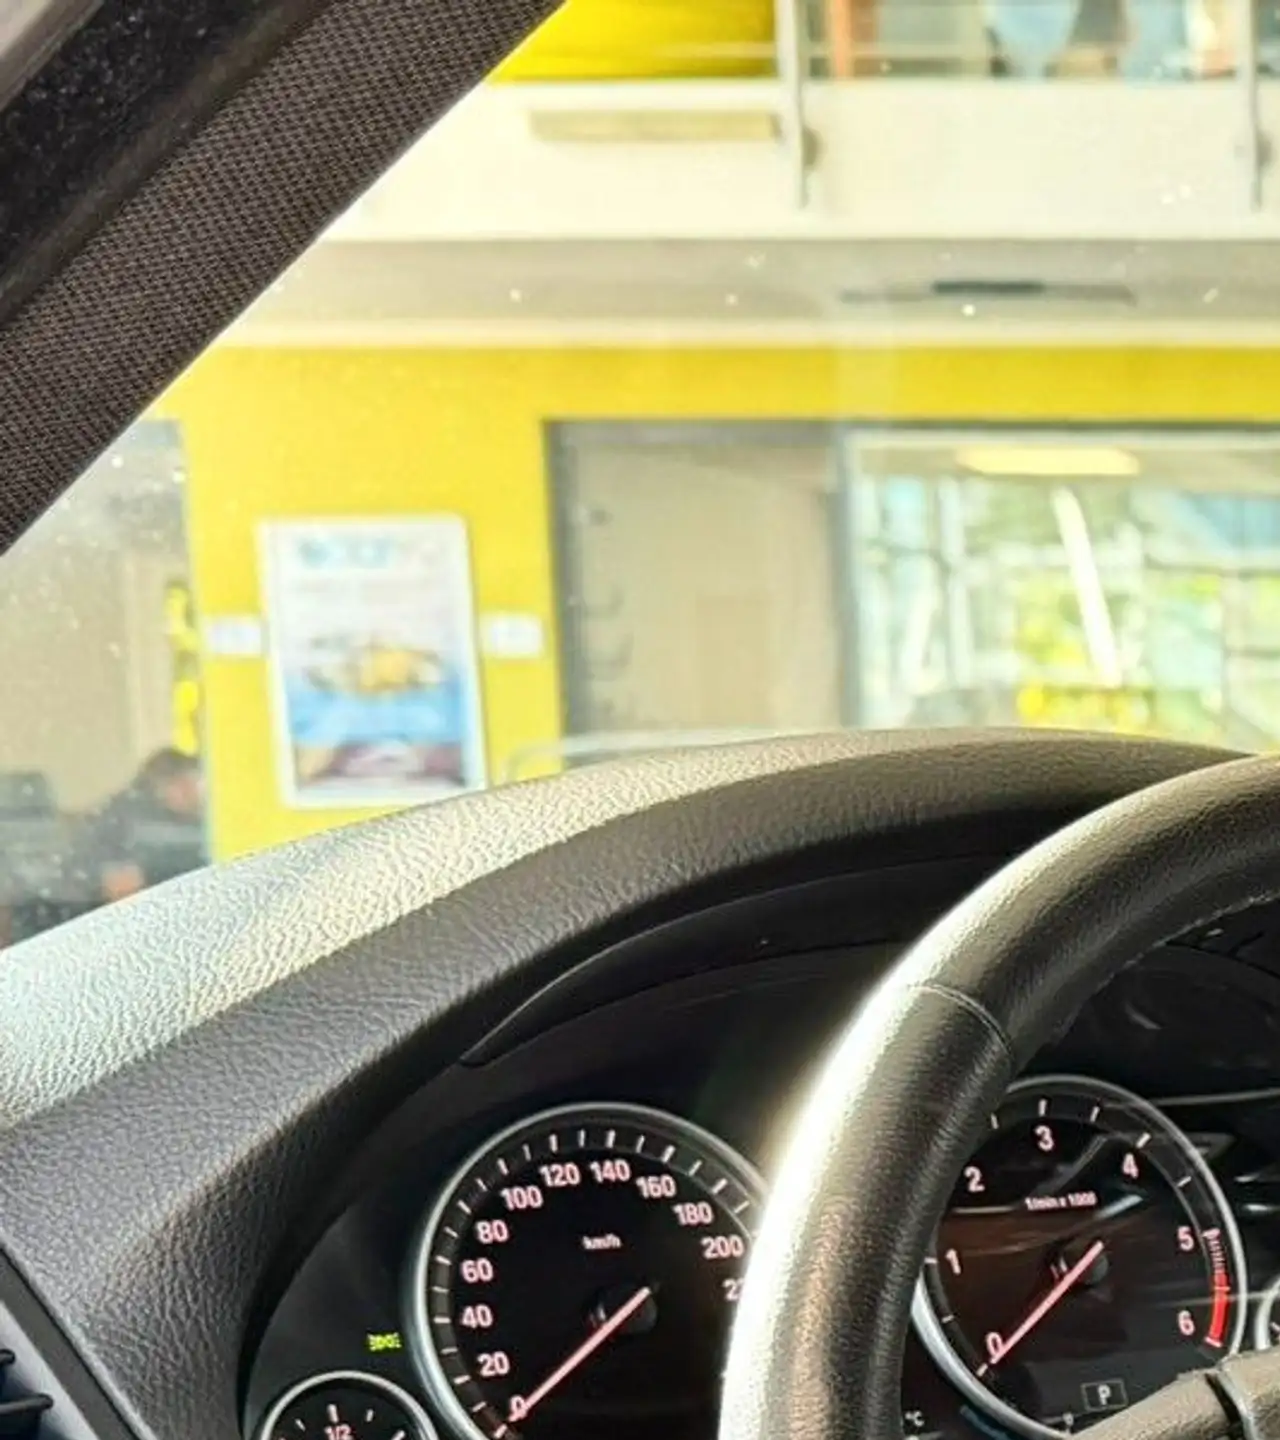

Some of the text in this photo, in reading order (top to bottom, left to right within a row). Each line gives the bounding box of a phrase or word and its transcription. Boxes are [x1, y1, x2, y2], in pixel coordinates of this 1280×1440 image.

[1034, 1124, 1056, 1152] 3
[539, 1161, 582, 1187] 120
[589, 1158, 632, 1183] 140
[963, 1165, 986, 1194] 2
[1122, 1152, 1140, 1180] 4
[500, 1184, 544, 1210] 100
[636, 1174, 677, 1200] 160
[673, 1201, 714, 1227] 180
[475, 1219, 510, 1246] 80
[582, 1233, 623, 1250] km/h
[1176, 1224, 1195, 1252] 5
[702, 1234, 745, 1260] 200
[461, 1257, 494, 1284] 60
[945, 1248, 962, 1276] 1
[461, 1303, 494, 1329] 40
[1177, 1309, 1195, 1336] 6
[476, 1351, 511, 1378] 20
